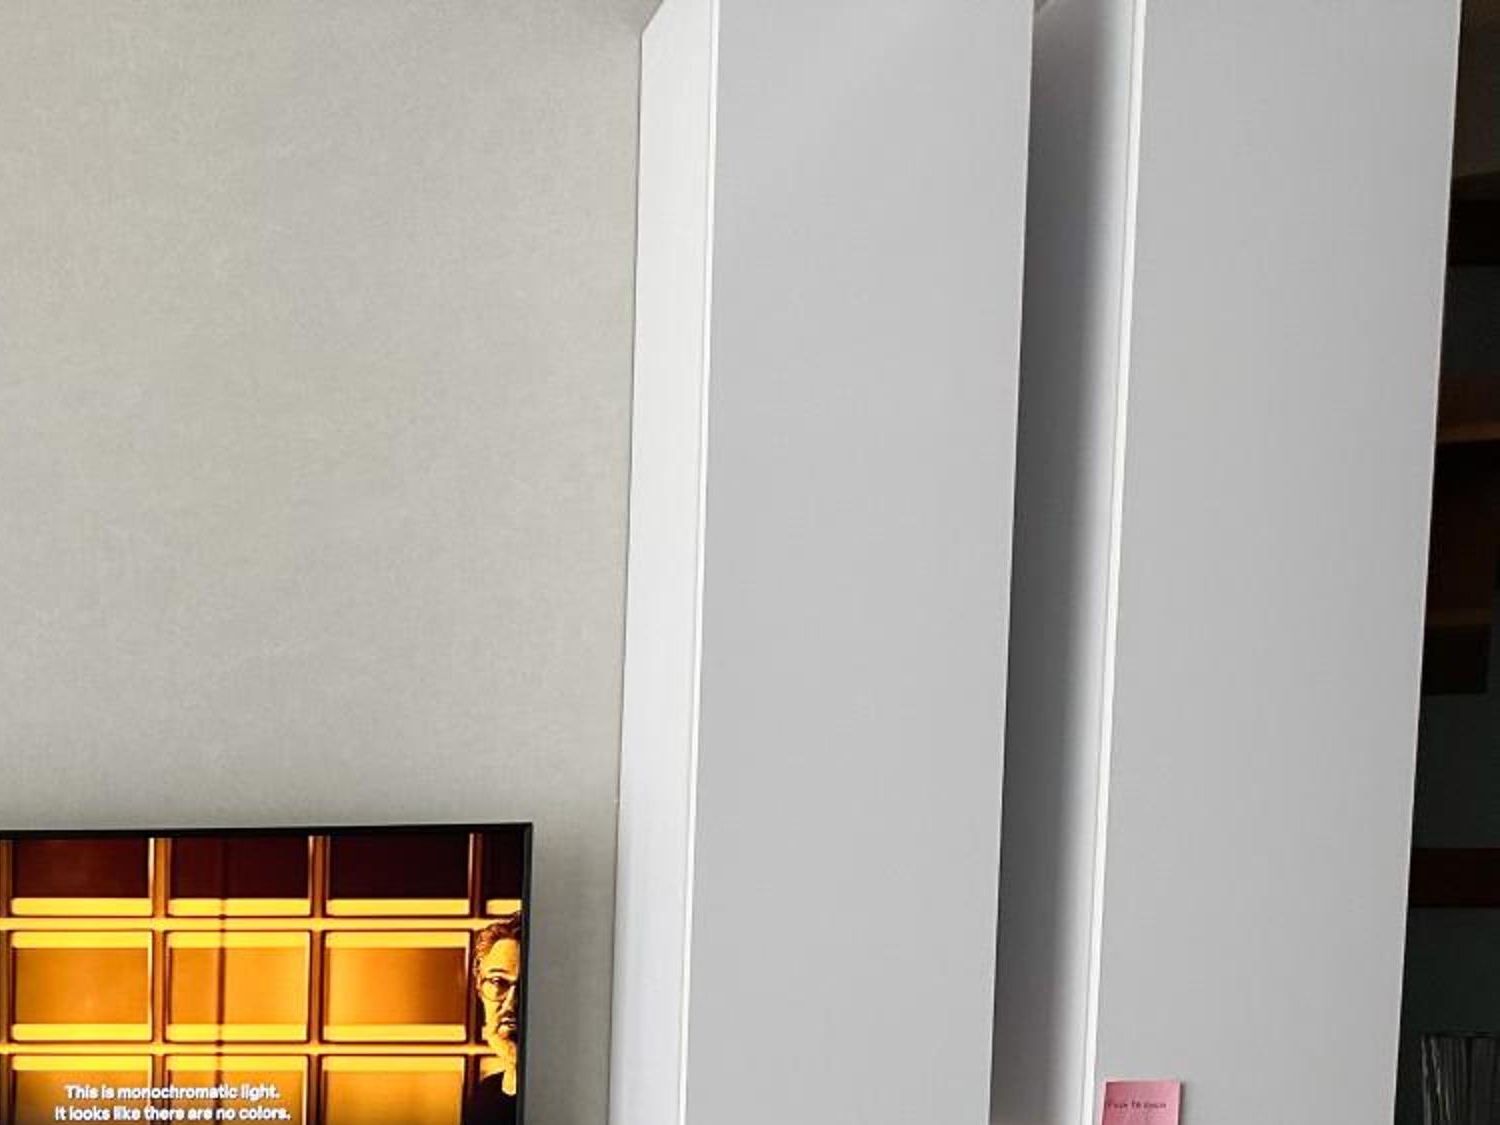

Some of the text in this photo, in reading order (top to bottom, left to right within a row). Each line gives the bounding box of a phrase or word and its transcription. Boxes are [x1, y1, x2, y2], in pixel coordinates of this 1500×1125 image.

[65, 1084, 279, 1100] This is monochromatic light.
[55, 1106, 291, 1121] It looks like there are no colors.
